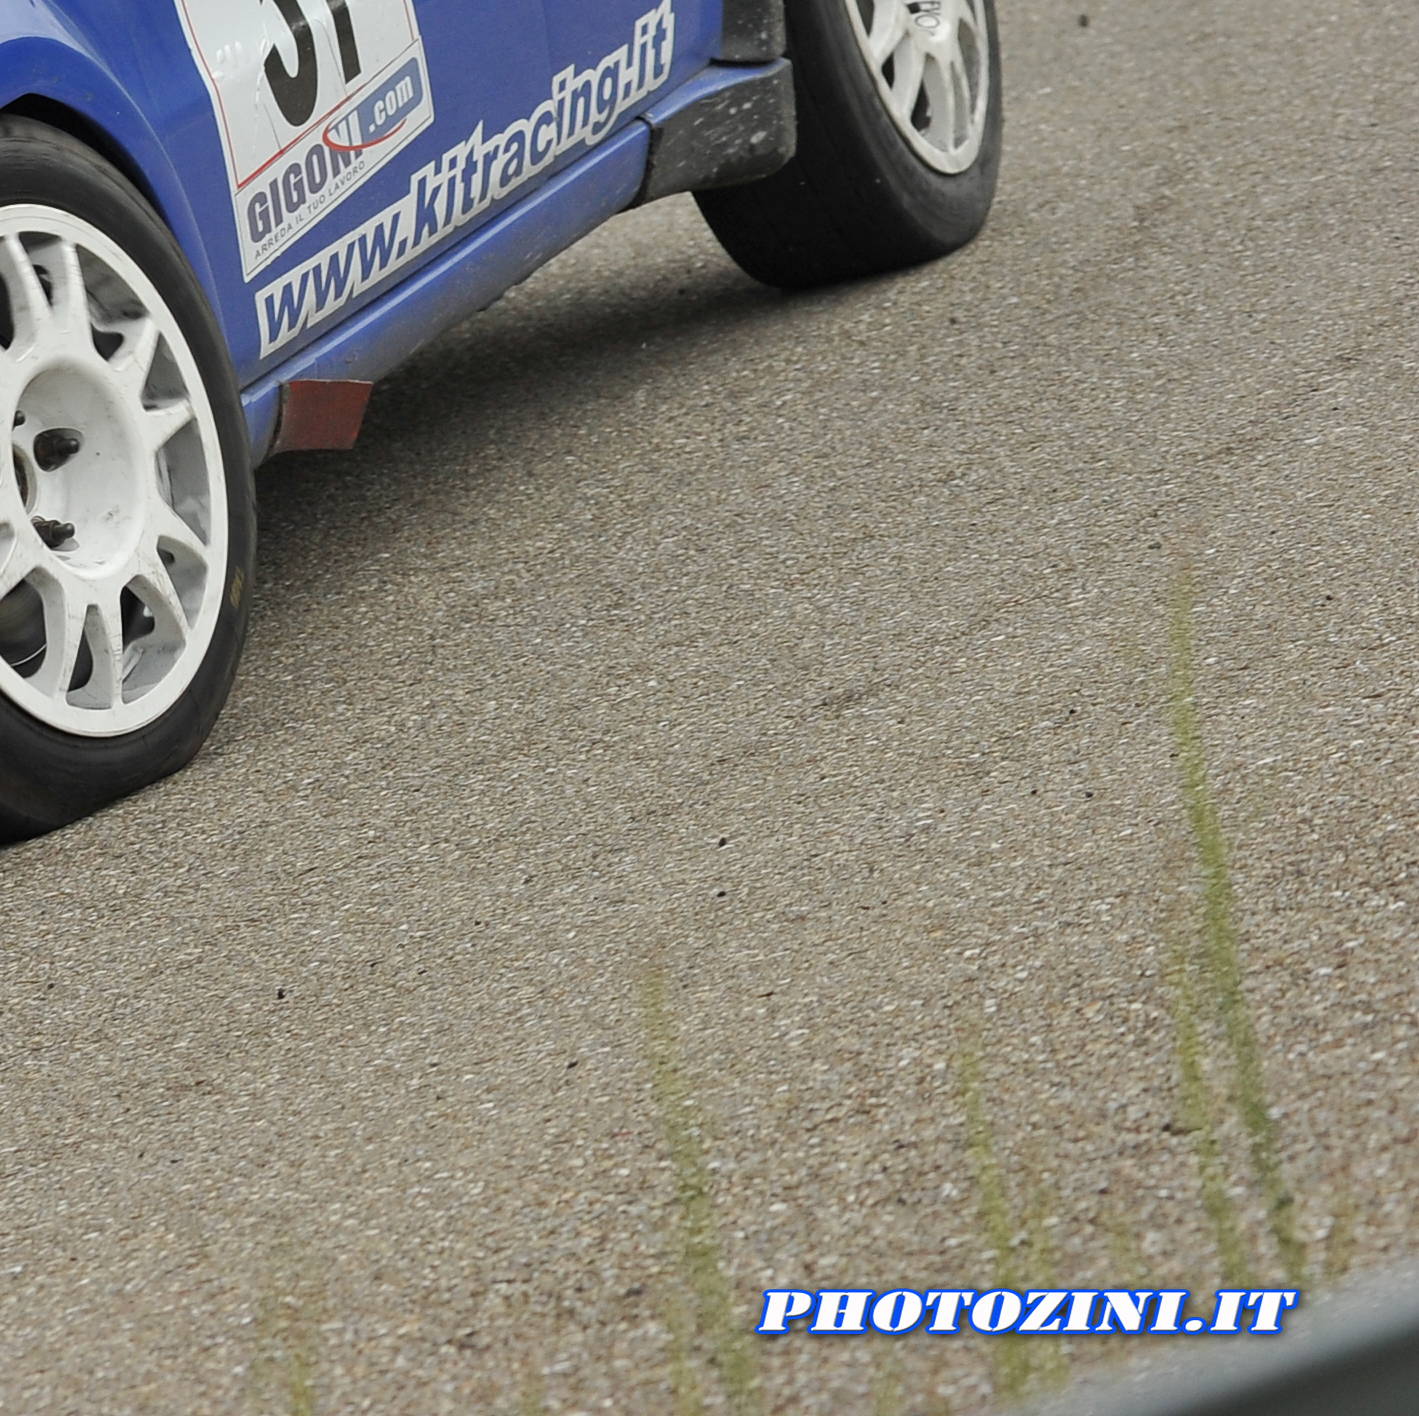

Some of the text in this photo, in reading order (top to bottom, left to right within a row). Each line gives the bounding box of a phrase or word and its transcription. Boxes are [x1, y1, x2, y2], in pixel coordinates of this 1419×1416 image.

[254, 160, 366, 261] ARREDA IL TUO LAVORO
